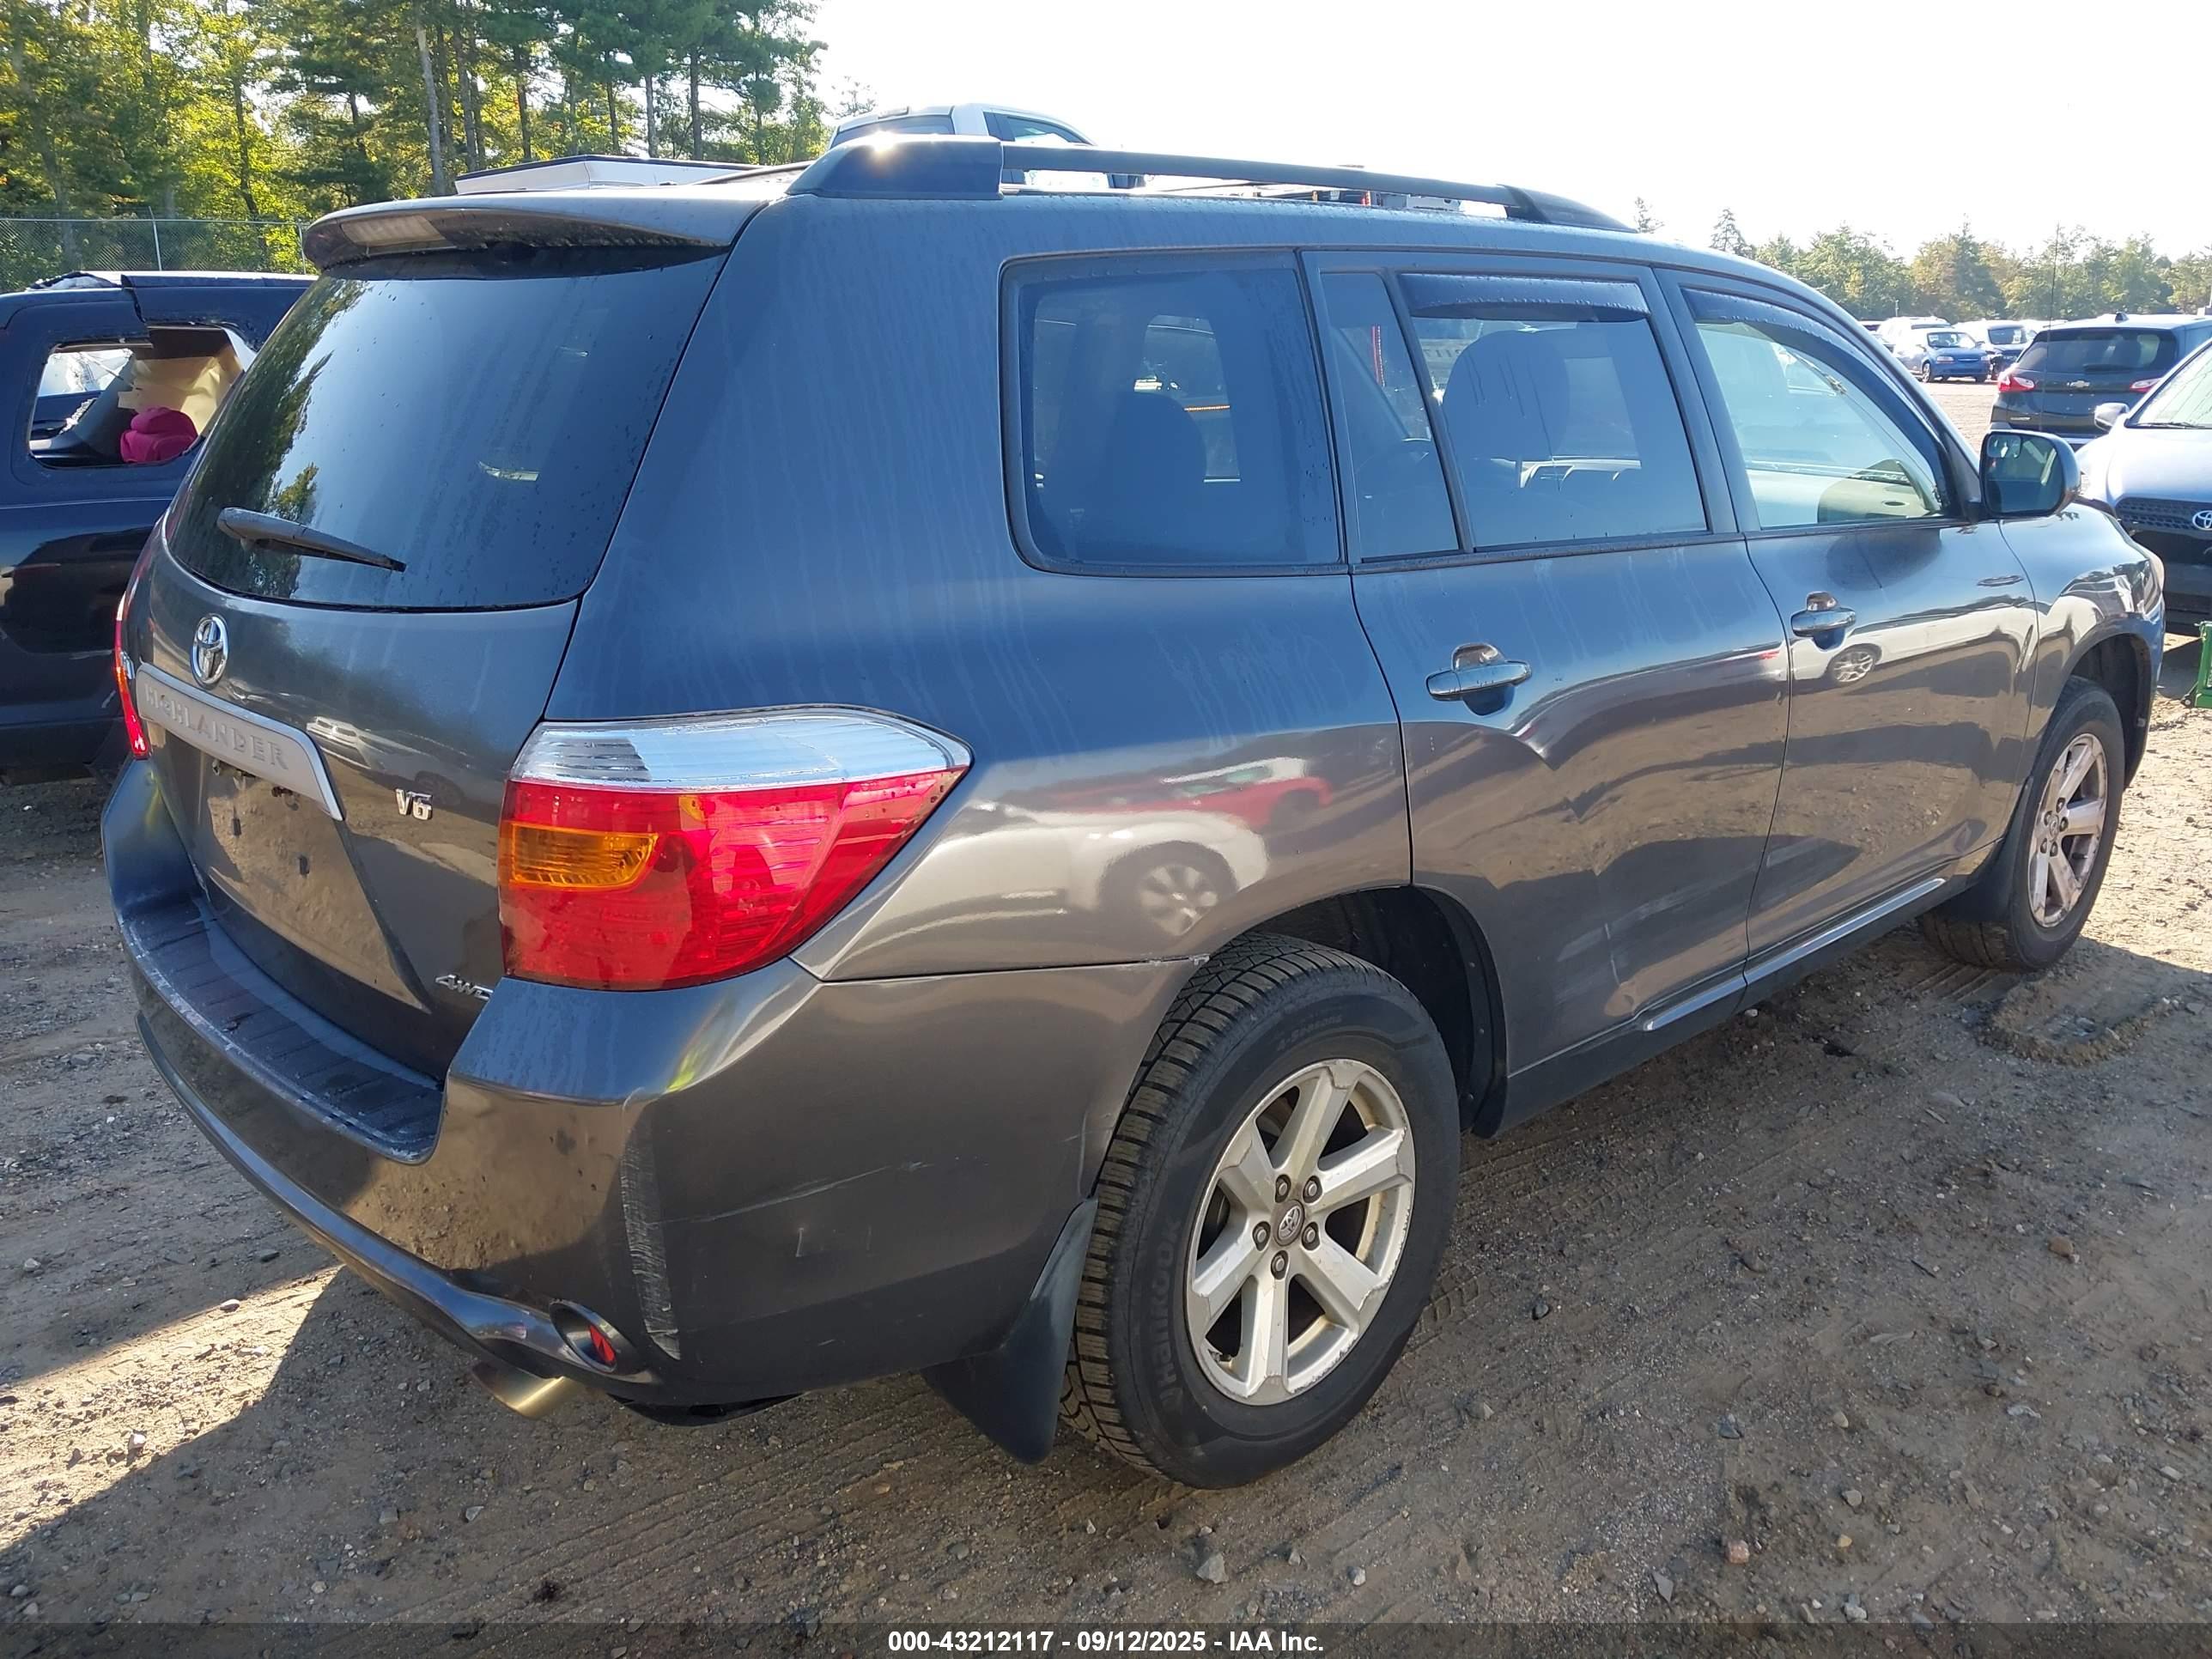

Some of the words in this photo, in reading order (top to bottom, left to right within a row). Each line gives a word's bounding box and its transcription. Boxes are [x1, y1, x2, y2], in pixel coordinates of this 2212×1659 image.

[143, 683, 290, 771] HIGHLANDER
[395, 788, 433, 821] V6
[434, 974, 495, 1001] 4WD
